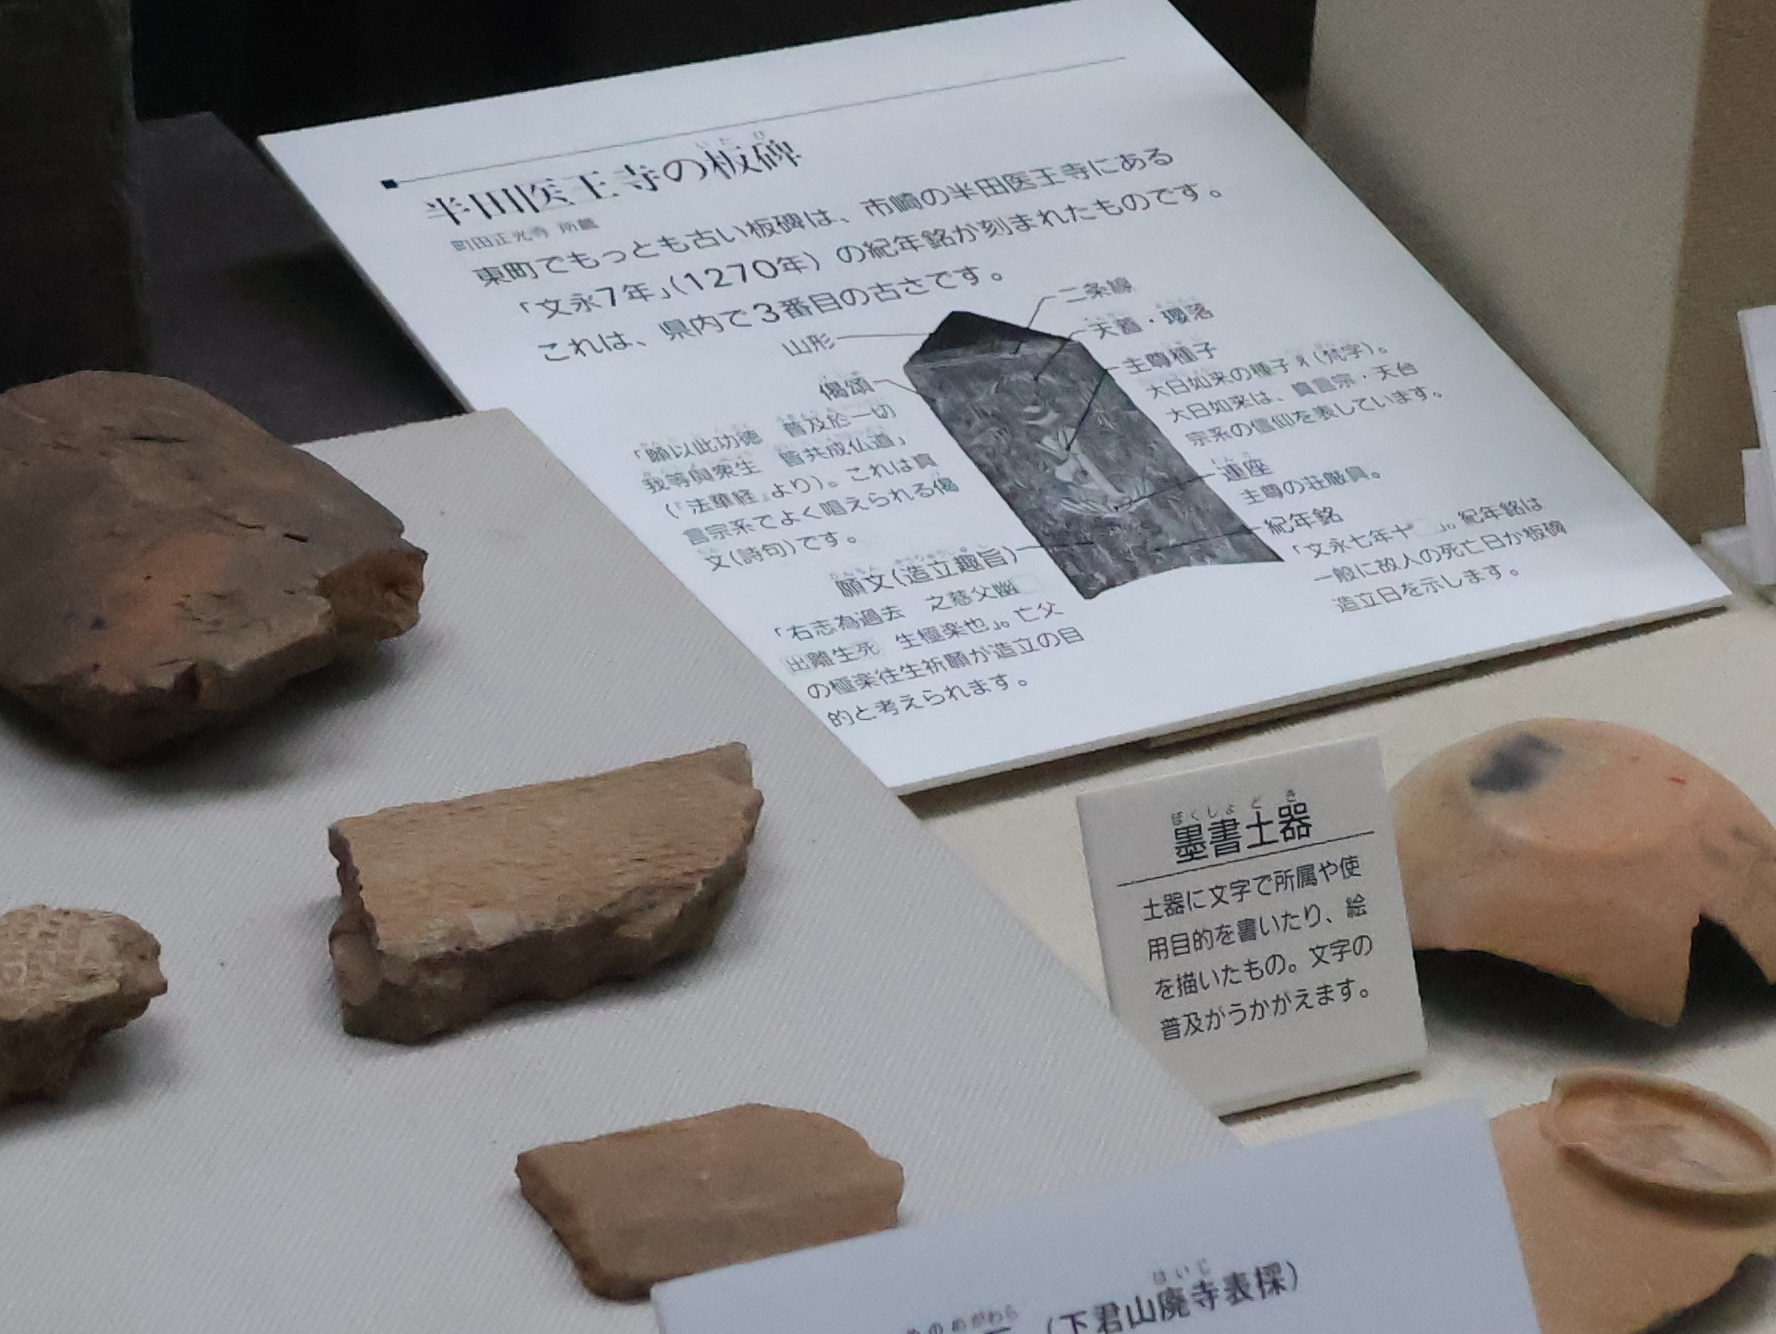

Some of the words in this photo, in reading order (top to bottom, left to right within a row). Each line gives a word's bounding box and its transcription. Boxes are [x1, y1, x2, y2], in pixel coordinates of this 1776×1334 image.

[425, 139, 802, 226] 半田医王寺の板碑
[471, 147, 1173, 287] 東町でもっとも古い板碑は、市崎の半田医王寺にある
[538, 265, 1003, 361] これは、県内で3番目の古さです。
[782, 333, 835, 357] 山形
[1263, 506, 1344, 535] 紀年銘
[1332, 564, 1519, 613] 造立日を示します。
[827, 674, 1027, 727] 的と考えられます。
[1173, 801, 1313, 865] 墨書土器
[1142, 854, 1363, 923] 土器に文字で所属や使
[1147, 894, 1369, 962] 用目的を書いたり、絵
[1154, 934, 1374, 1002] を描いたもの。文字の
[1159, 976, 1371, 1043] 普及がうかがえます。
[1148, 1255, 1214, 1288] はいじ
